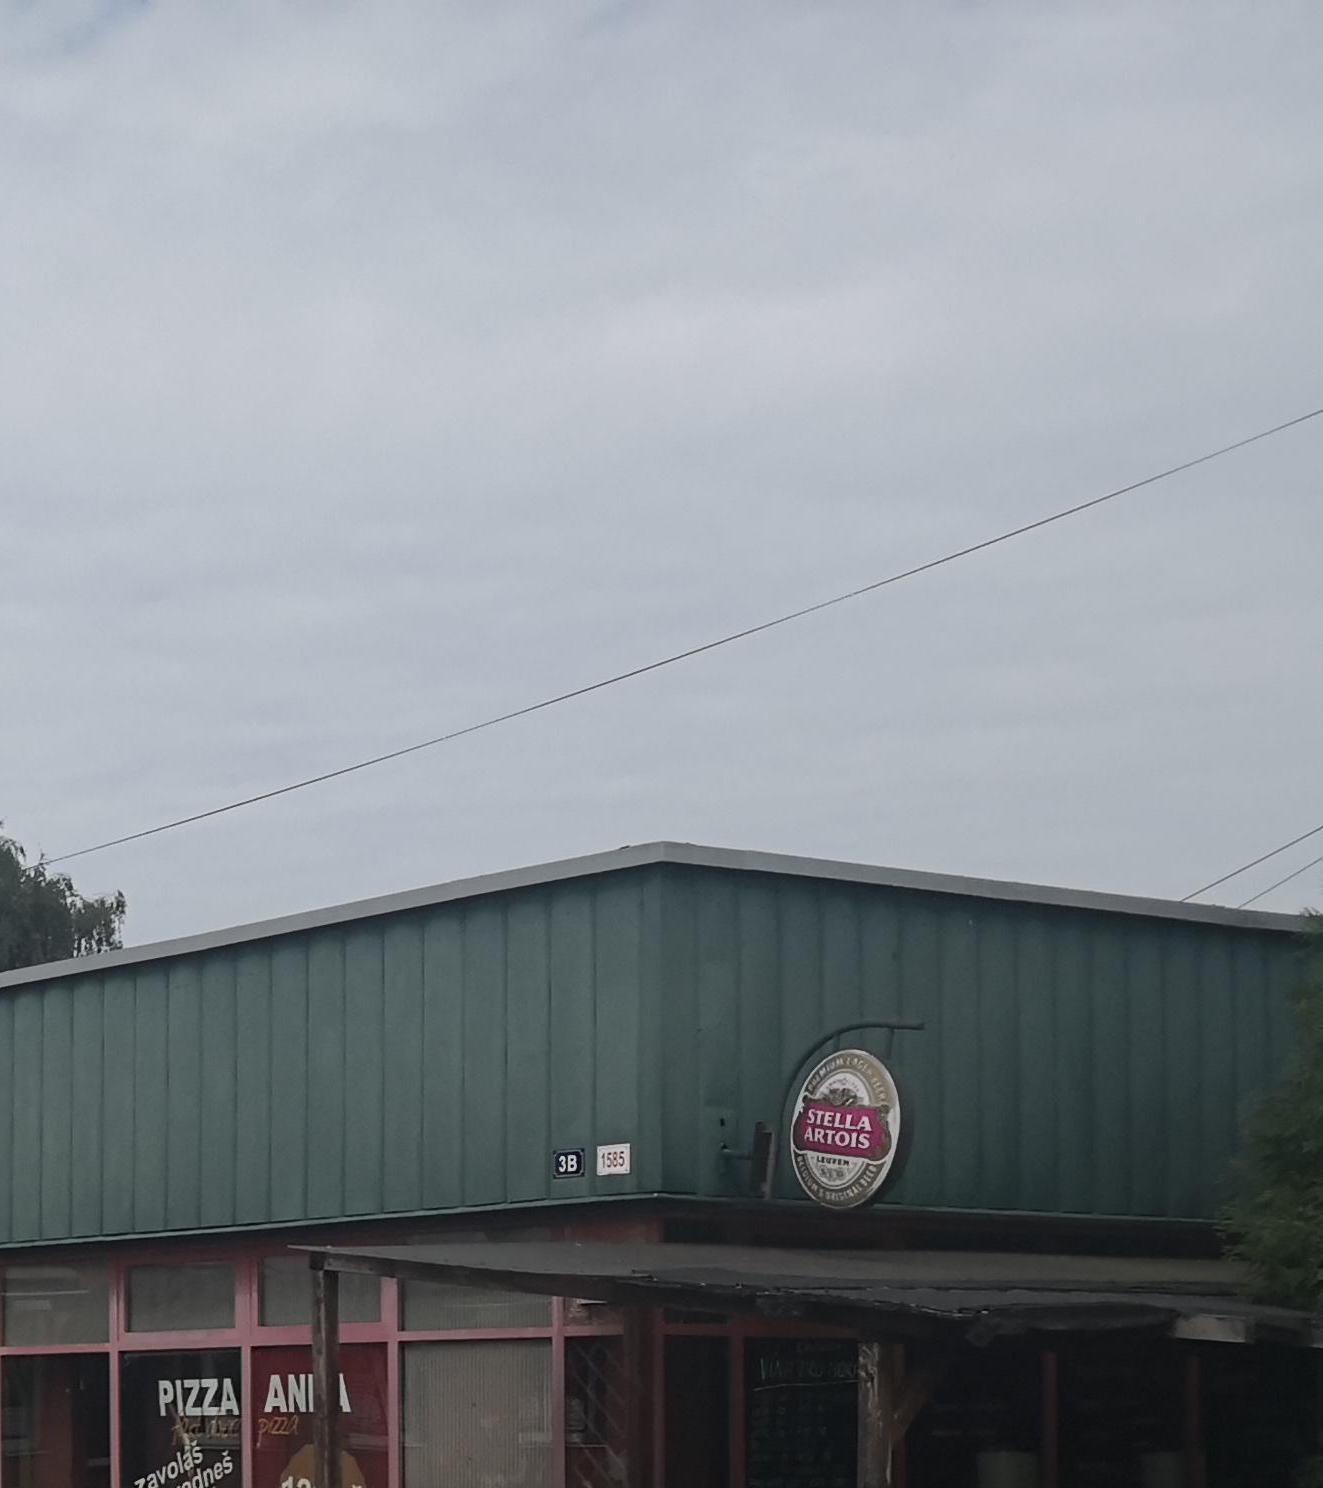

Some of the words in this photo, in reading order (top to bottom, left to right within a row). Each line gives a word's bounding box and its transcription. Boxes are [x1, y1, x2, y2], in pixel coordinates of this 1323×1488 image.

[806, 1108, 873, 1132] STELLA
[804, 1126, 871, 1149] ARTOIS
[558, 1155, 578, 1173] 3B
[601, 1151, 625, 1168] 1585
[158, 1378, 240, 1416] PIZZA
[264, 1373, 352, 1413] ANIA
